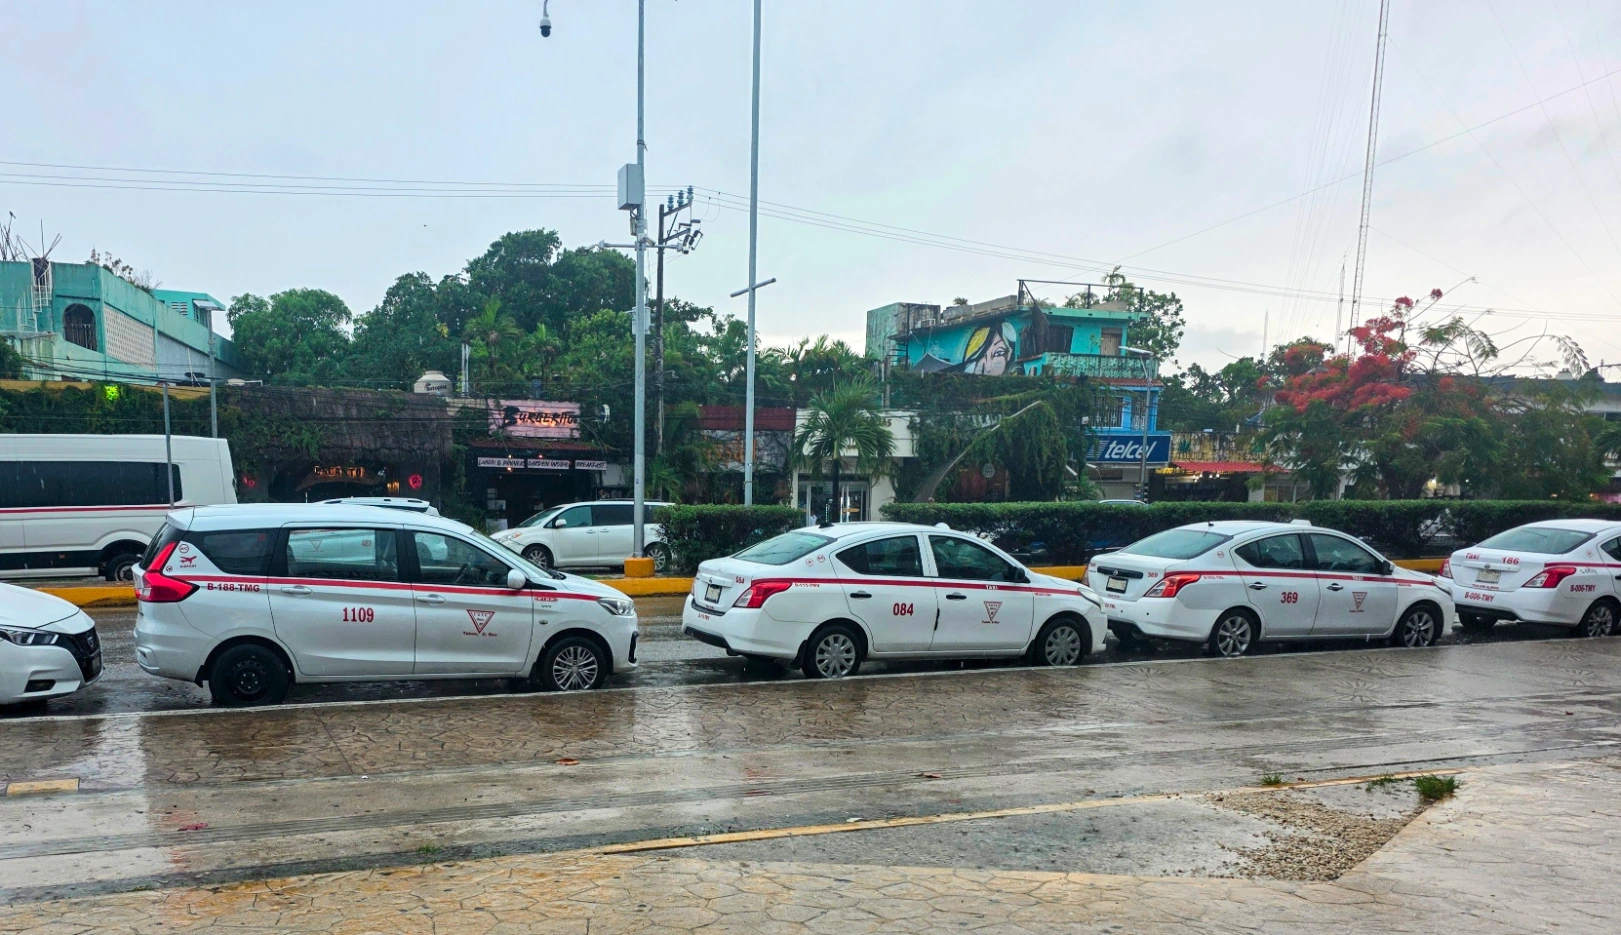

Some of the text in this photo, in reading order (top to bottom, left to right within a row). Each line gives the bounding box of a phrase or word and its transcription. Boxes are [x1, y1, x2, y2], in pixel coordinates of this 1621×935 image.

[1104, 440, 1157, 459] telcel
[1465, 552, 1480, 560] Taxi
[1502, 556, 1520, 565] 166
[207, 583, 260, 593] B-188-TMG
[1571, 584, 1596, 592] B-006-TMY
[1280, 591, 1299, 604] 369
[1465, 591, 1495, 602] B-006-TMY
[342, 606, 375, 623] 1109
[893, 602, 914, 617] 084
